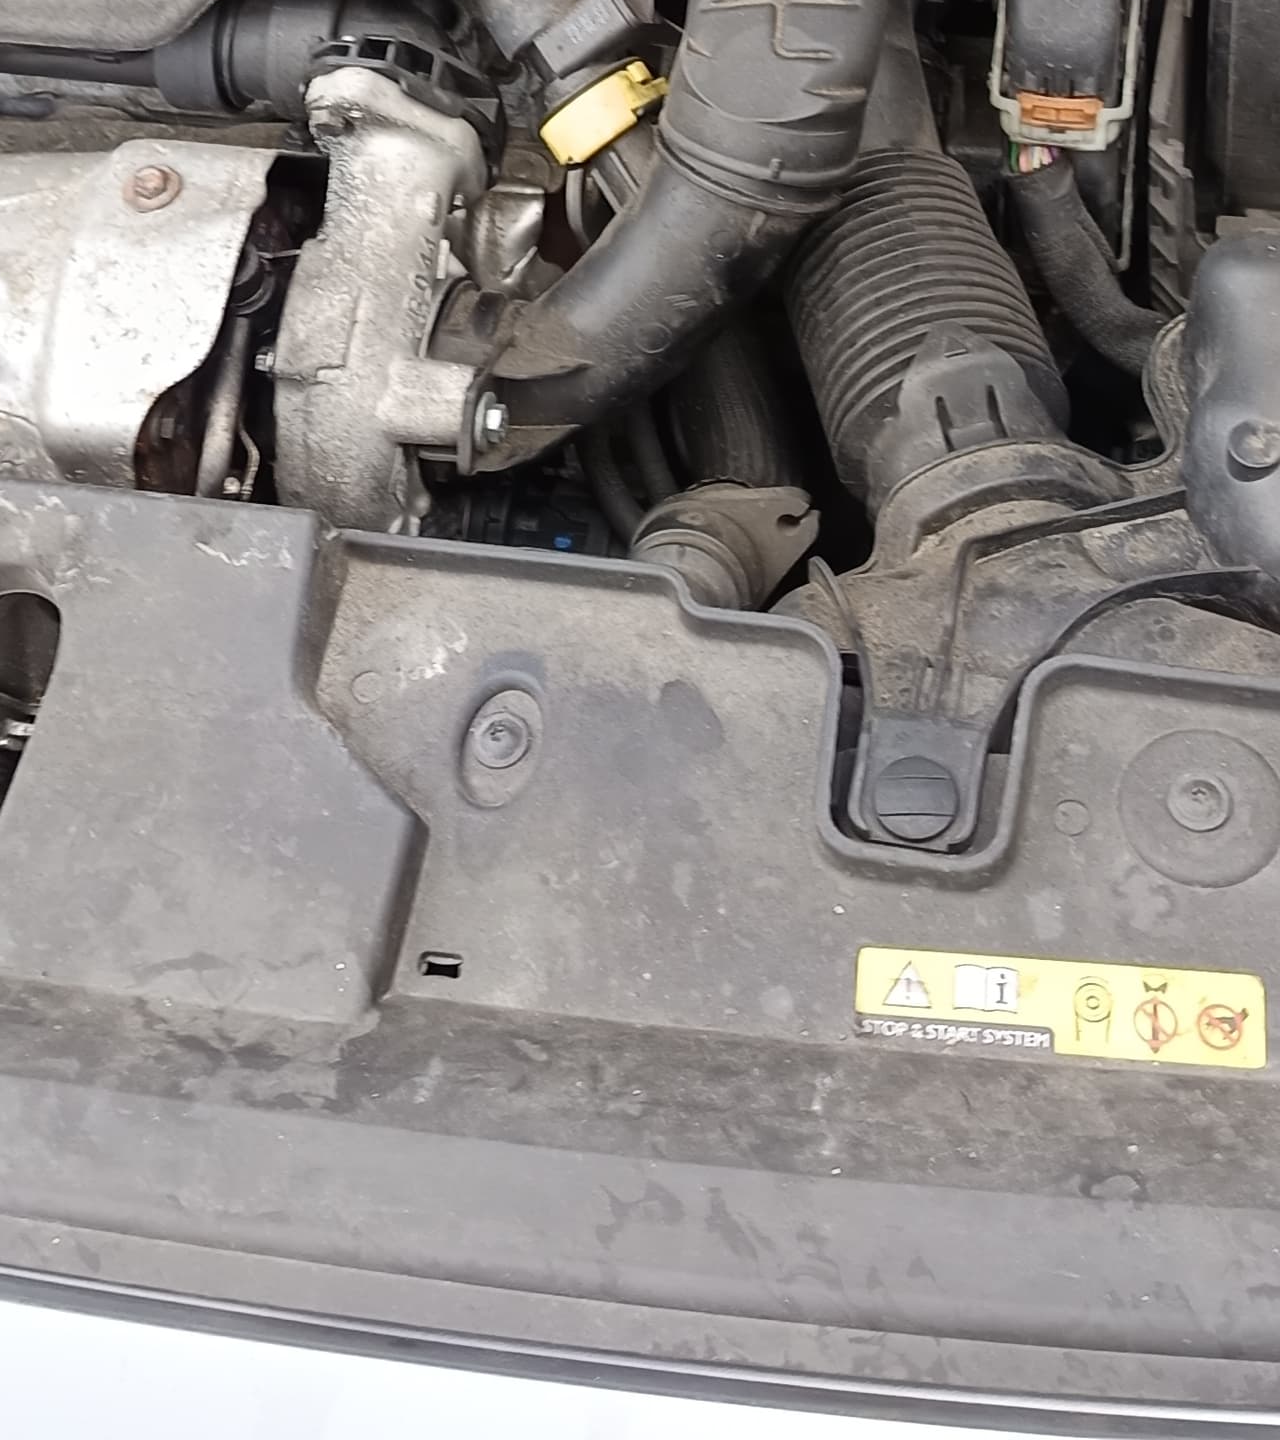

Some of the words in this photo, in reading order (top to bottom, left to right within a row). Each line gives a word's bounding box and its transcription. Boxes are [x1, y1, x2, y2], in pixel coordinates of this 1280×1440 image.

[861, 1019, 910, 1037] STOP
[925, 1024, 982, 1043] START
[981, 1028, 1051, 1048] SYSTEM
